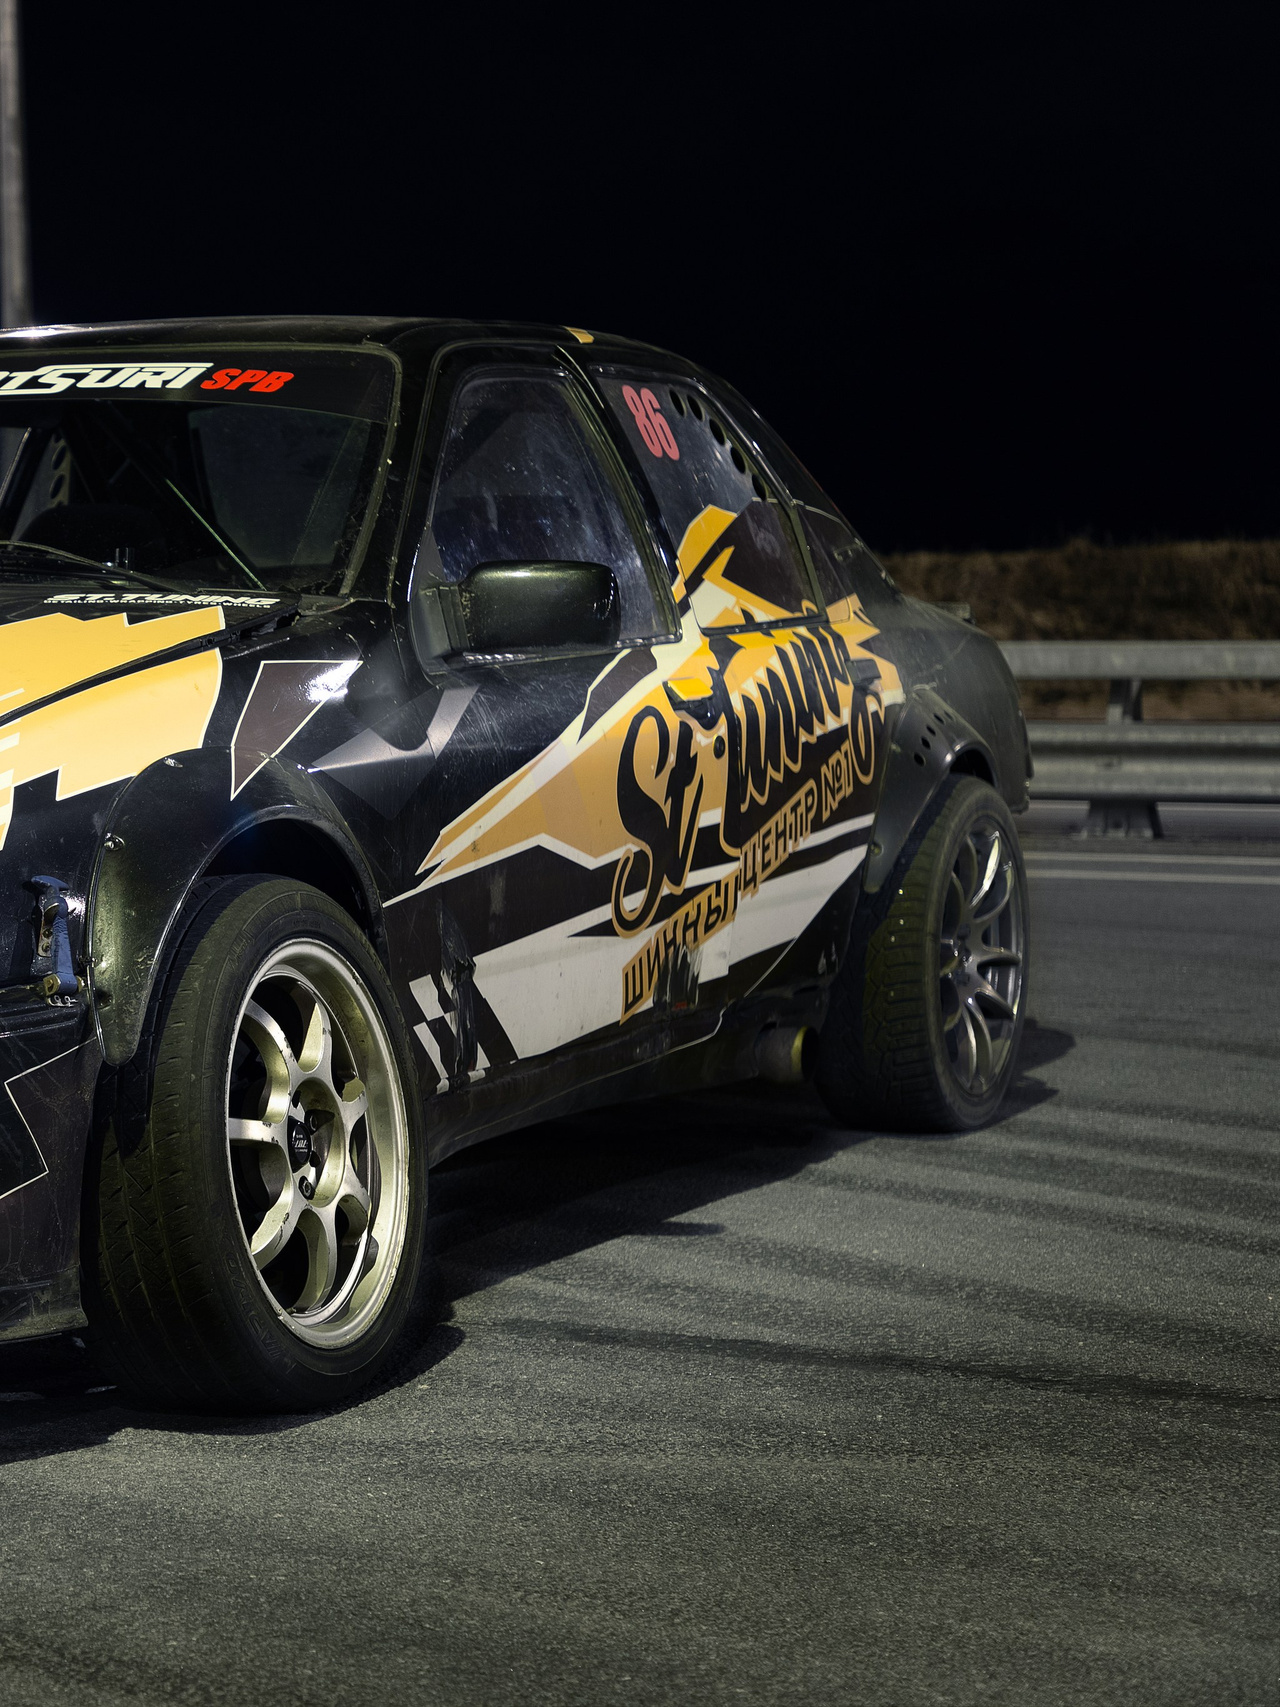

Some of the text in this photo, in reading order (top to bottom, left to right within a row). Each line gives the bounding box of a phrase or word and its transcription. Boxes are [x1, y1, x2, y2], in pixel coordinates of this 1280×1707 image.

[199, 367, 295, 394] SPB
[621, 384, 680, 462] 86
[740, 777, 818, 901] ЦЕНТР
